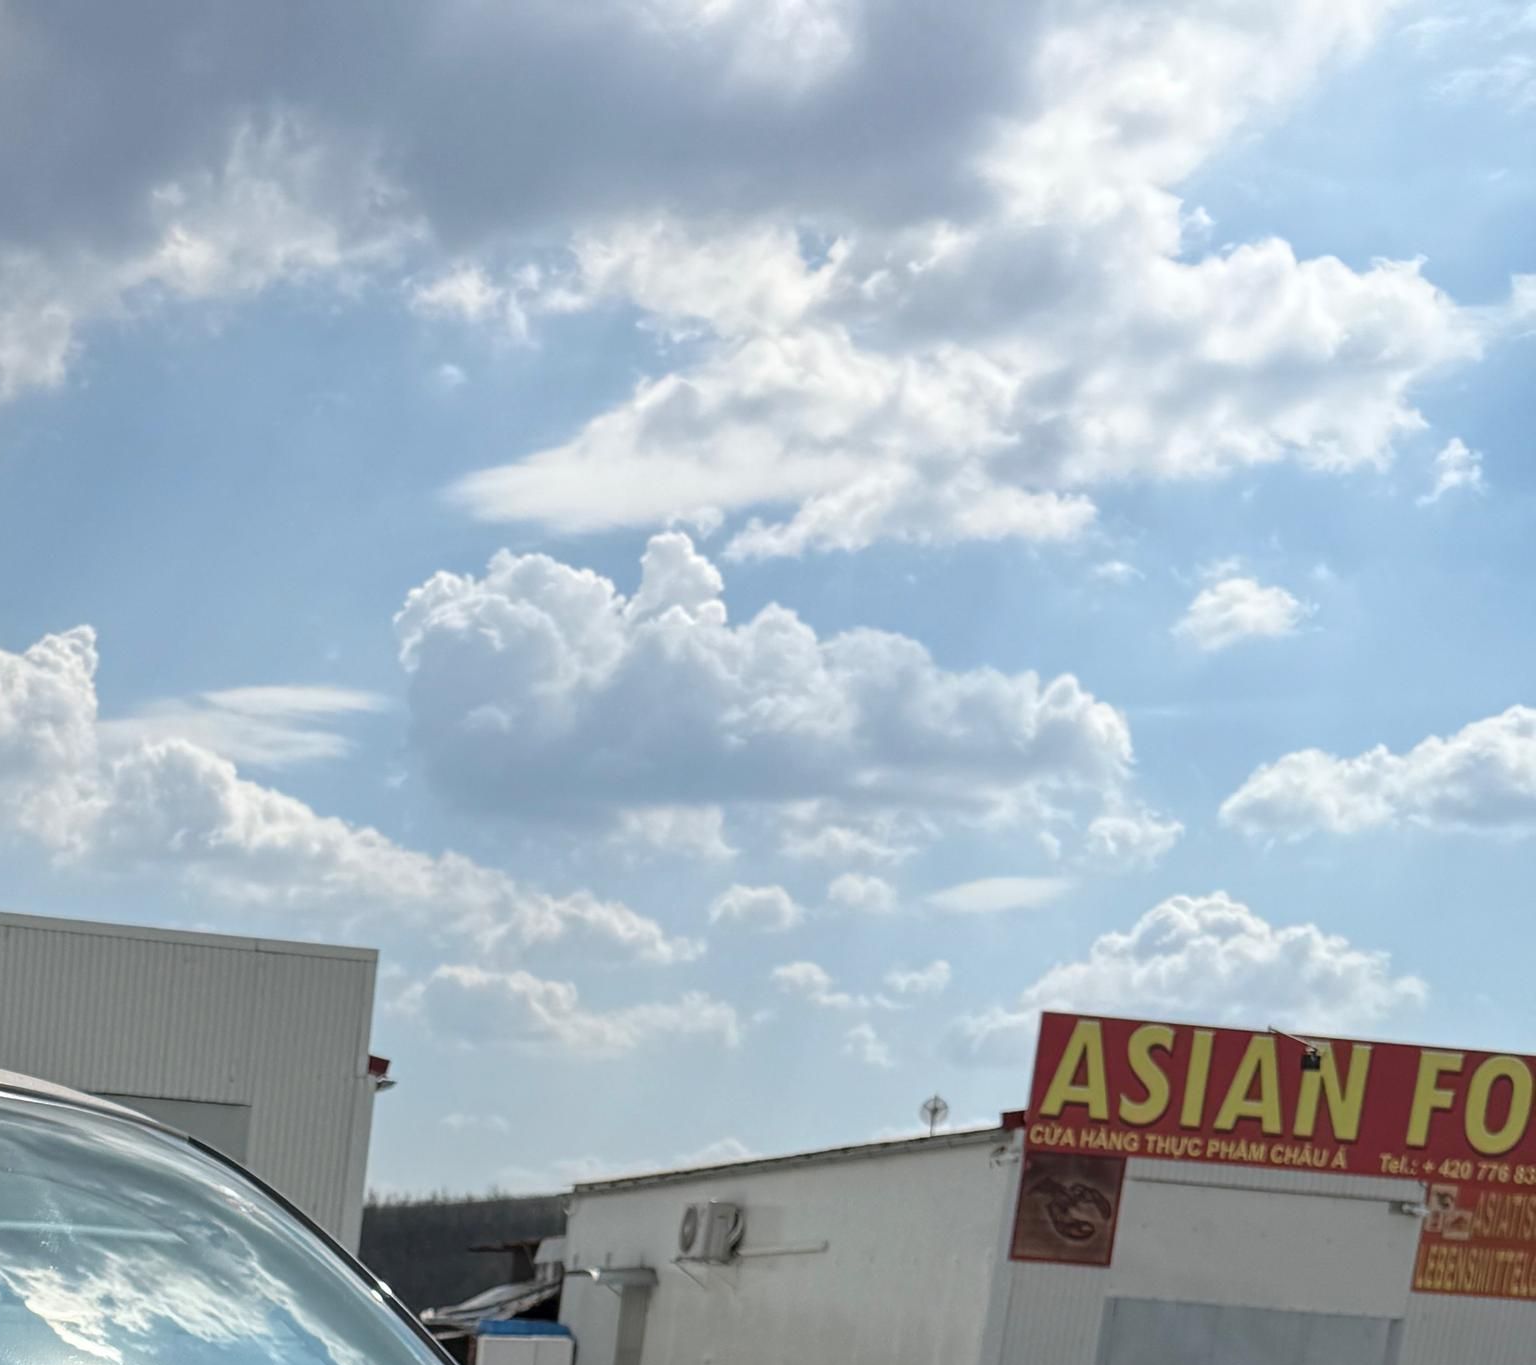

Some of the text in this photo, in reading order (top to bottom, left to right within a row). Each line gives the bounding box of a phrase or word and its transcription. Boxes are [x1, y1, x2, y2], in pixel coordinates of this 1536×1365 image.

[1039, 1019, 1533, 1155] ASIAN FO
[1079, 1126, 1140, 1152] HÀNG
[1145, 1132, 1202, 1158] THỰC
[1438, 1157, 1472, 1180] 420
[1477, 1161, 1511, 1183] 776
